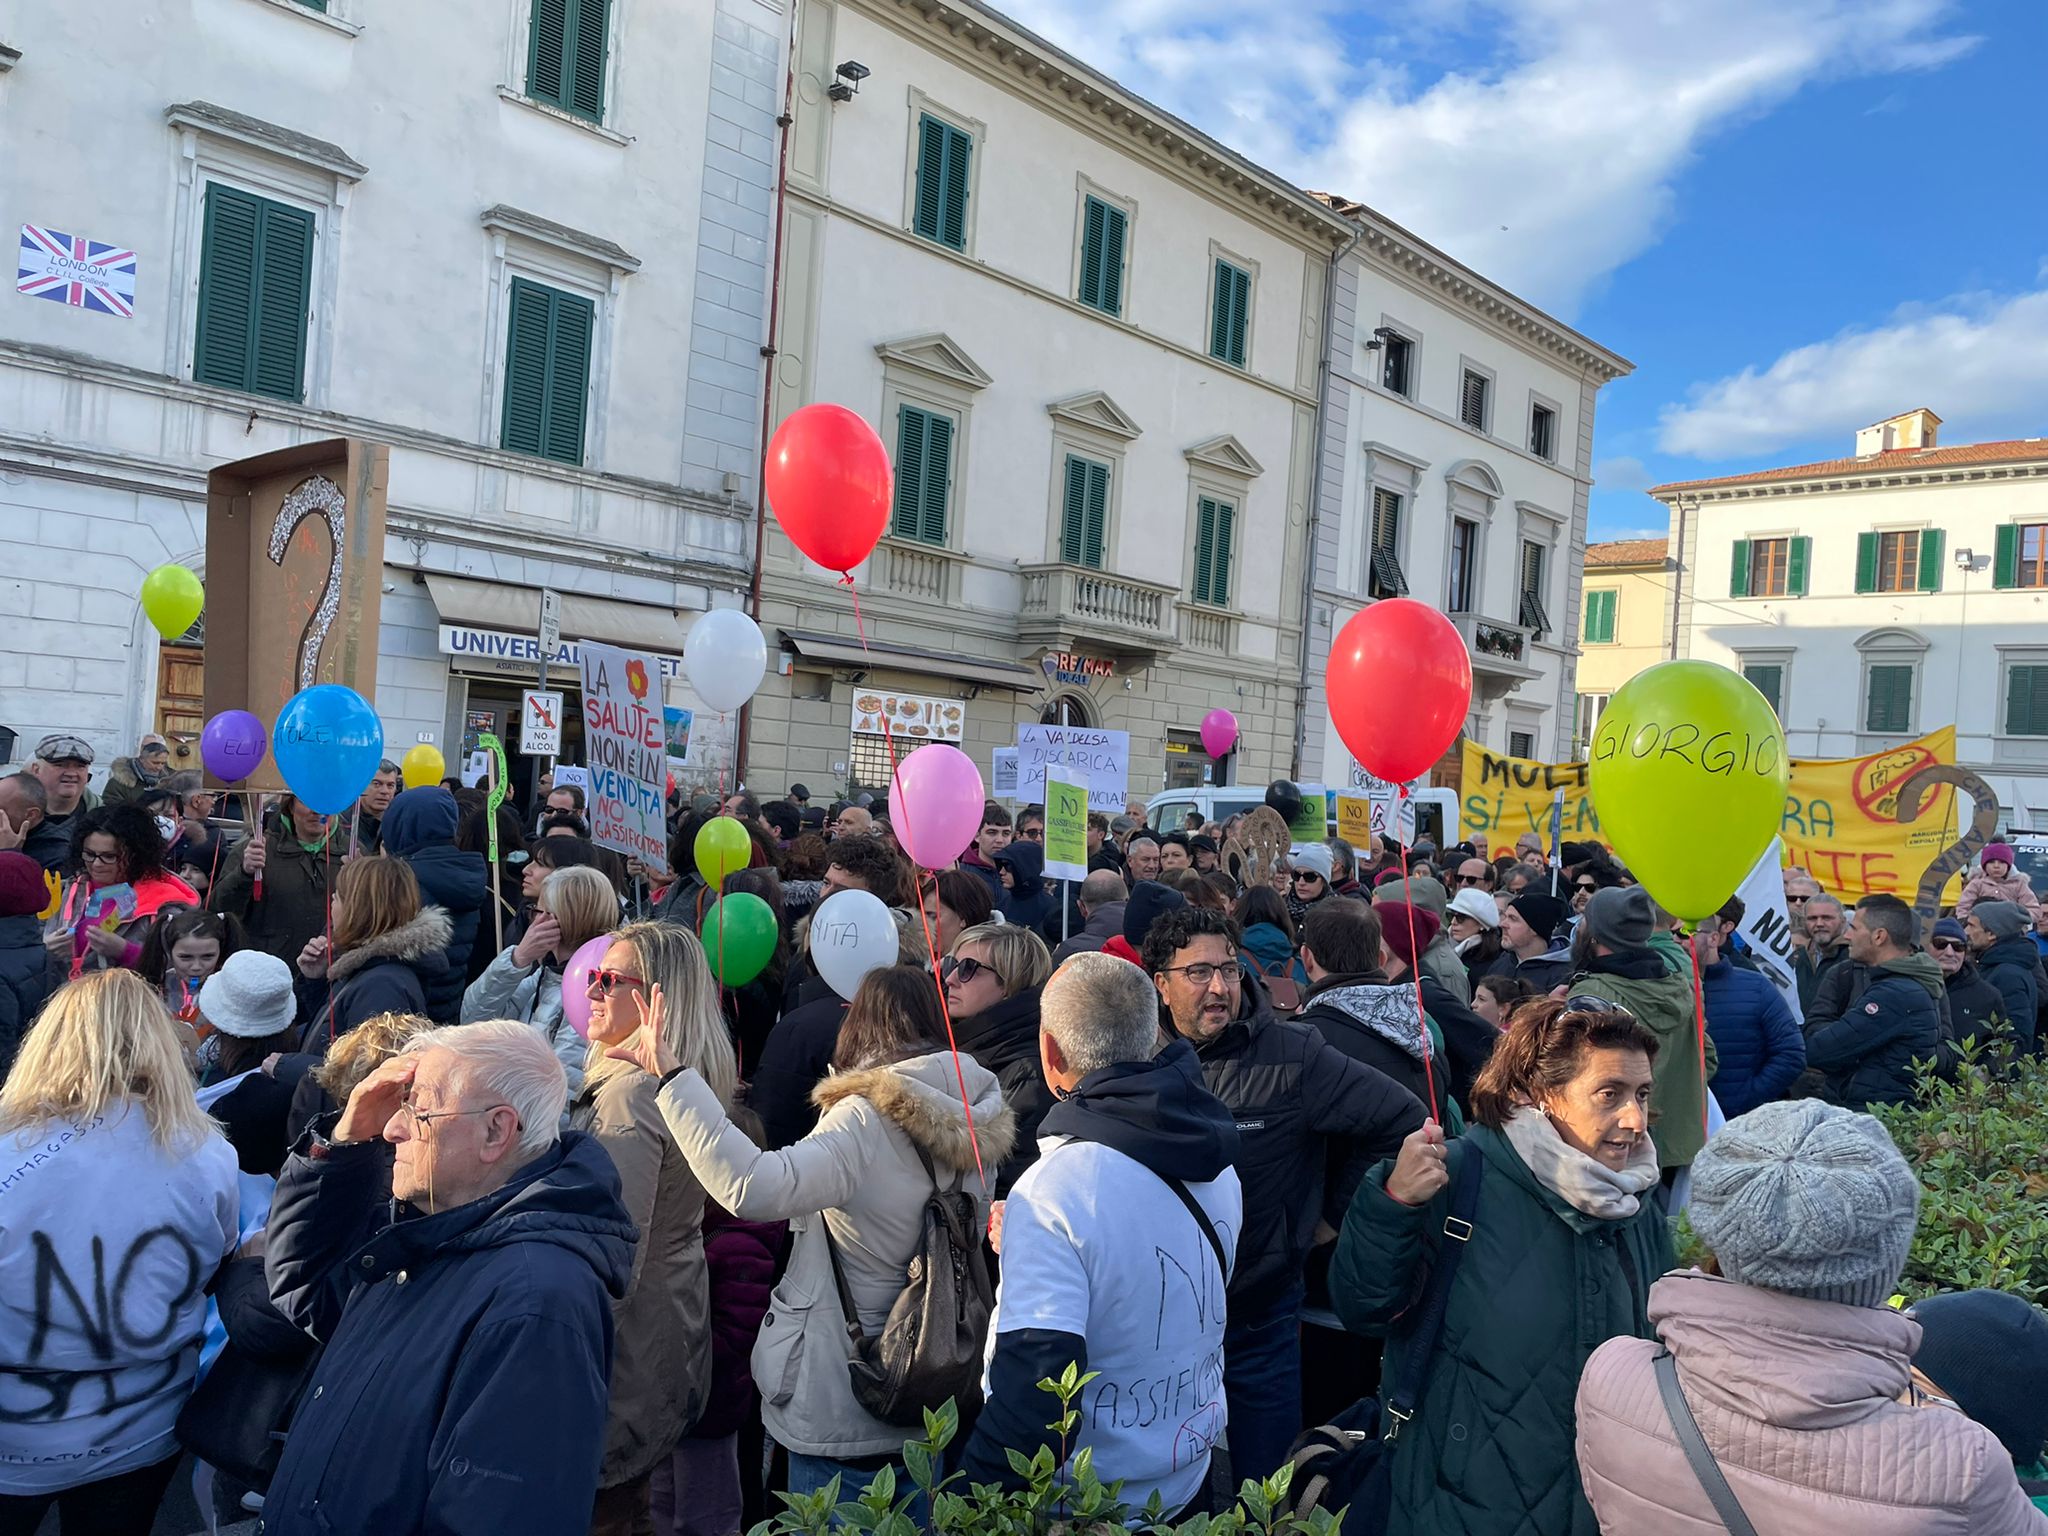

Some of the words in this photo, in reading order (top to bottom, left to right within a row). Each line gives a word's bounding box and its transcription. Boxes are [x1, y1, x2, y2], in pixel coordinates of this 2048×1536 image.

[50, 255, 108, 277] LONDON
[78, 274, 110, 288] College
[451, 630, 580, 665] UNIVERAL
[1058, 652, 1113, 677] RE/MAX
[584, 654, 611, 698] LA
[533, 732, 548, 741] NO
[586, 698, 663, 749] SALUTE
[525, 742, 556, 751] ALCOL
[591, 732, 625, 771] NON
[640, 747, 660, 787] IN
[1031, 747, 1118, 773] DISCARICA
[1594, 720, 1777, 776] GIORGIO
[566, 773, 582, 784] NO
[591, 766, 662, 819] VENDITA
[1961, 776, 1995, 813] CHE
[597, 795, 625, 823] NO
[1060, 795, 1079, 817] NO
[1346, 804, 1363, 819] NO
[595, 820, 665, 860] GASSIFICATORE
[1909, 837, 1935, 845] EMPOLI
[1930, 825, 1985, 875] ARIA
[1750, 907, 1791, 956] NO
[27, 1225, 200, 1361] NO
[1155, 1220, 1234, 1350] NO
